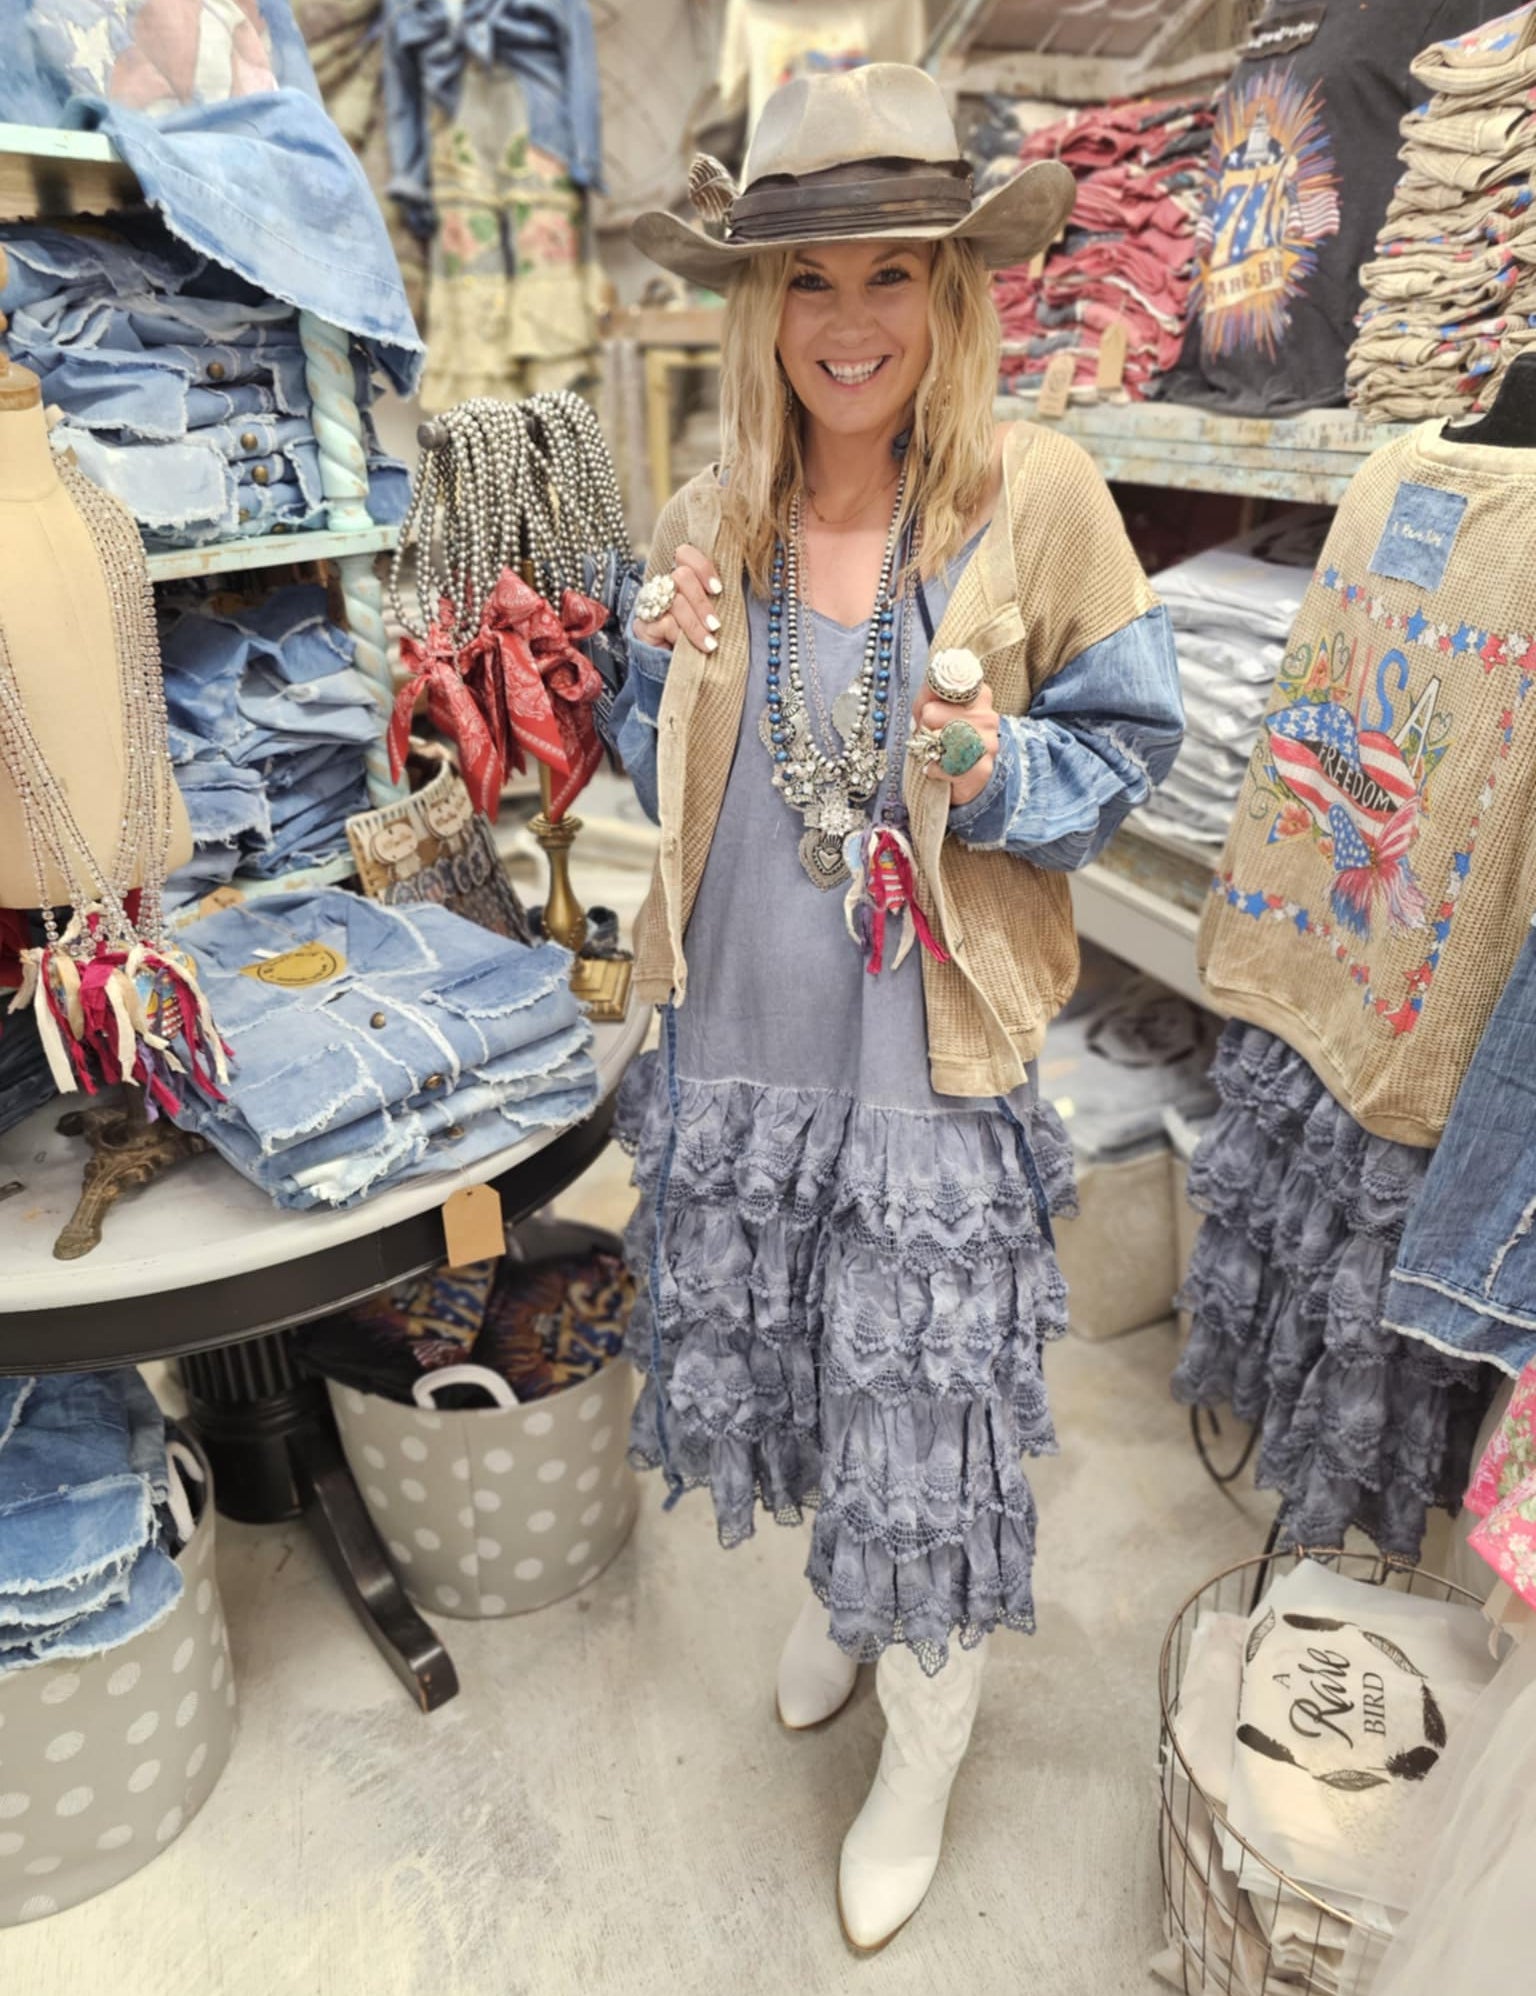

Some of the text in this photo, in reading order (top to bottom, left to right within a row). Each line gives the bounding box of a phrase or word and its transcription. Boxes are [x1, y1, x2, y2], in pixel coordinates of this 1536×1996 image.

[1317, 744, 1390, 813] FREEDOM
[1272, 1673, 1291, 1690] A
[1289, 1647, 1355, 1749] Rare
[1362, 1672, 1386, 1738] BIRD
